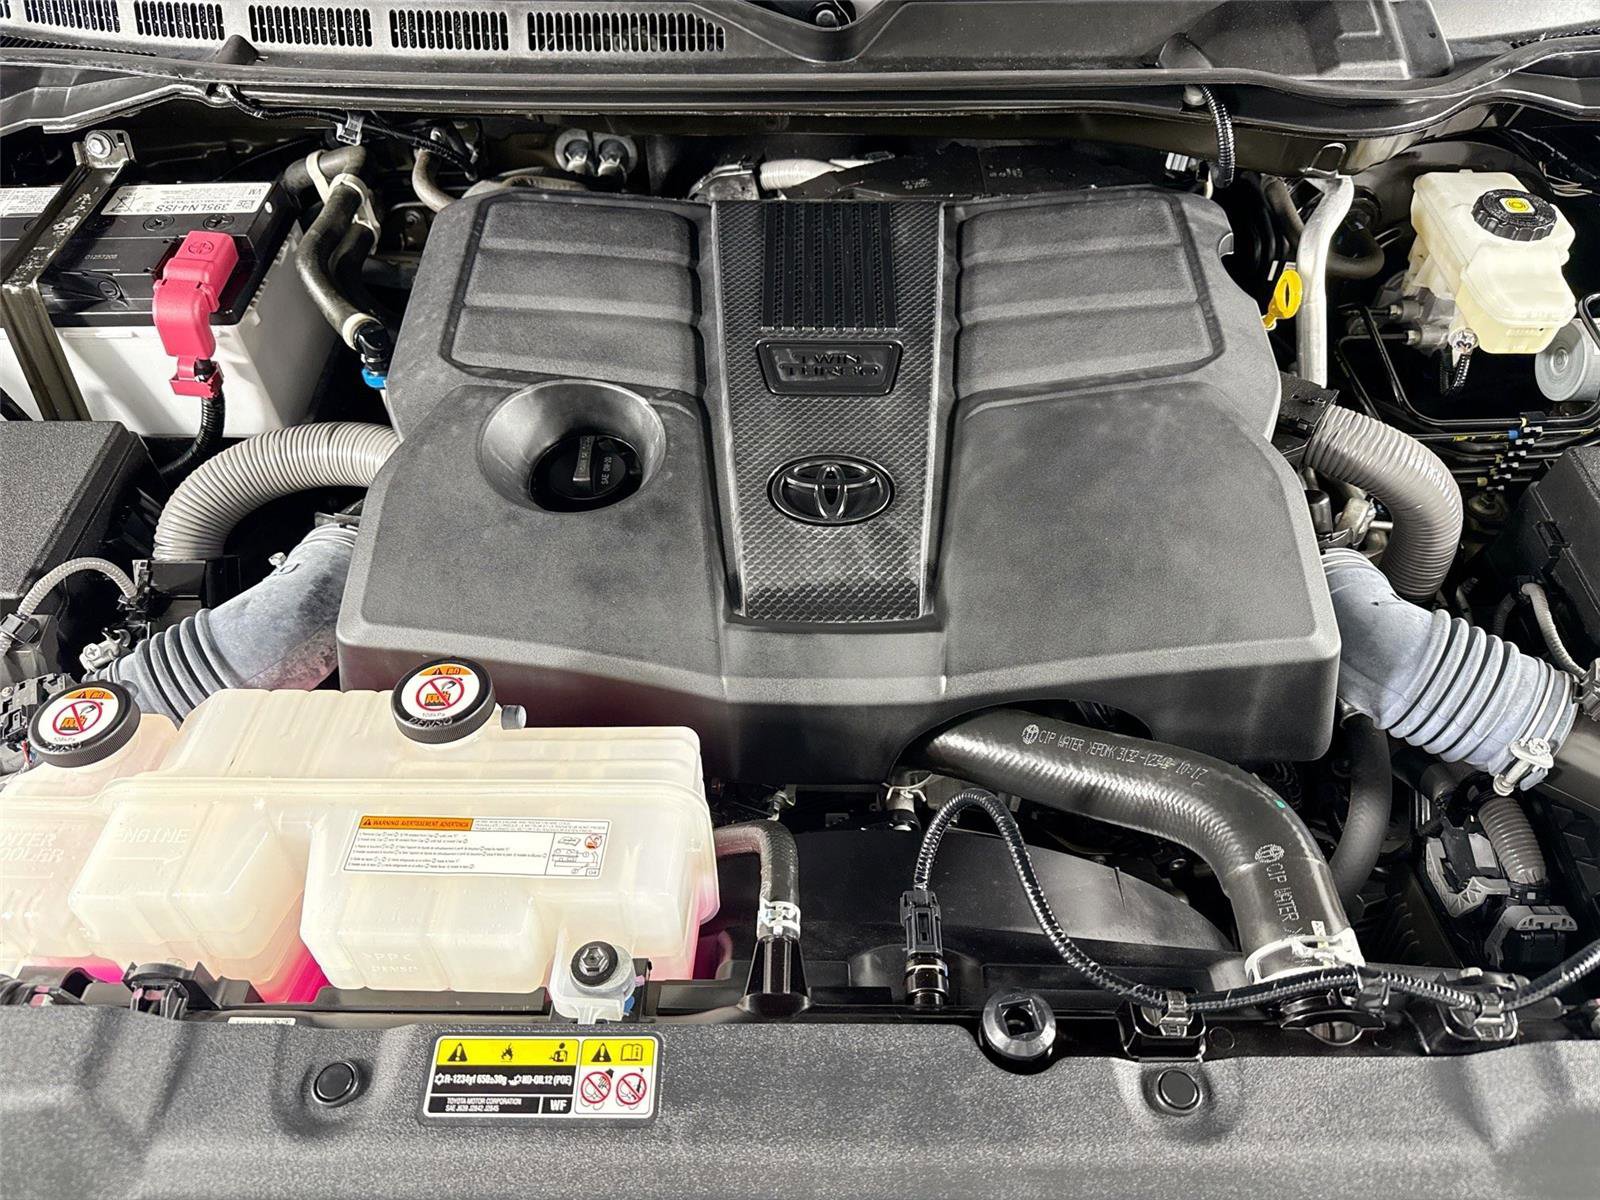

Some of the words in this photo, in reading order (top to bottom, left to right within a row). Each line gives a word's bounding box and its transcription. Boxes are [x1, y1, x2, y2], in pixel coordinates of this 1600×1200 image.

[1057, 734, 1085, 752] WATER
[0, 832, 57, 848] NTER
[446, 1097, 466, 1105] TOYOTA
[466, 1097, 485, 1105] MOTOR
[485, 1097, 522, 1105] CORPORATION
[550, 1099, 568, 1111] WF
